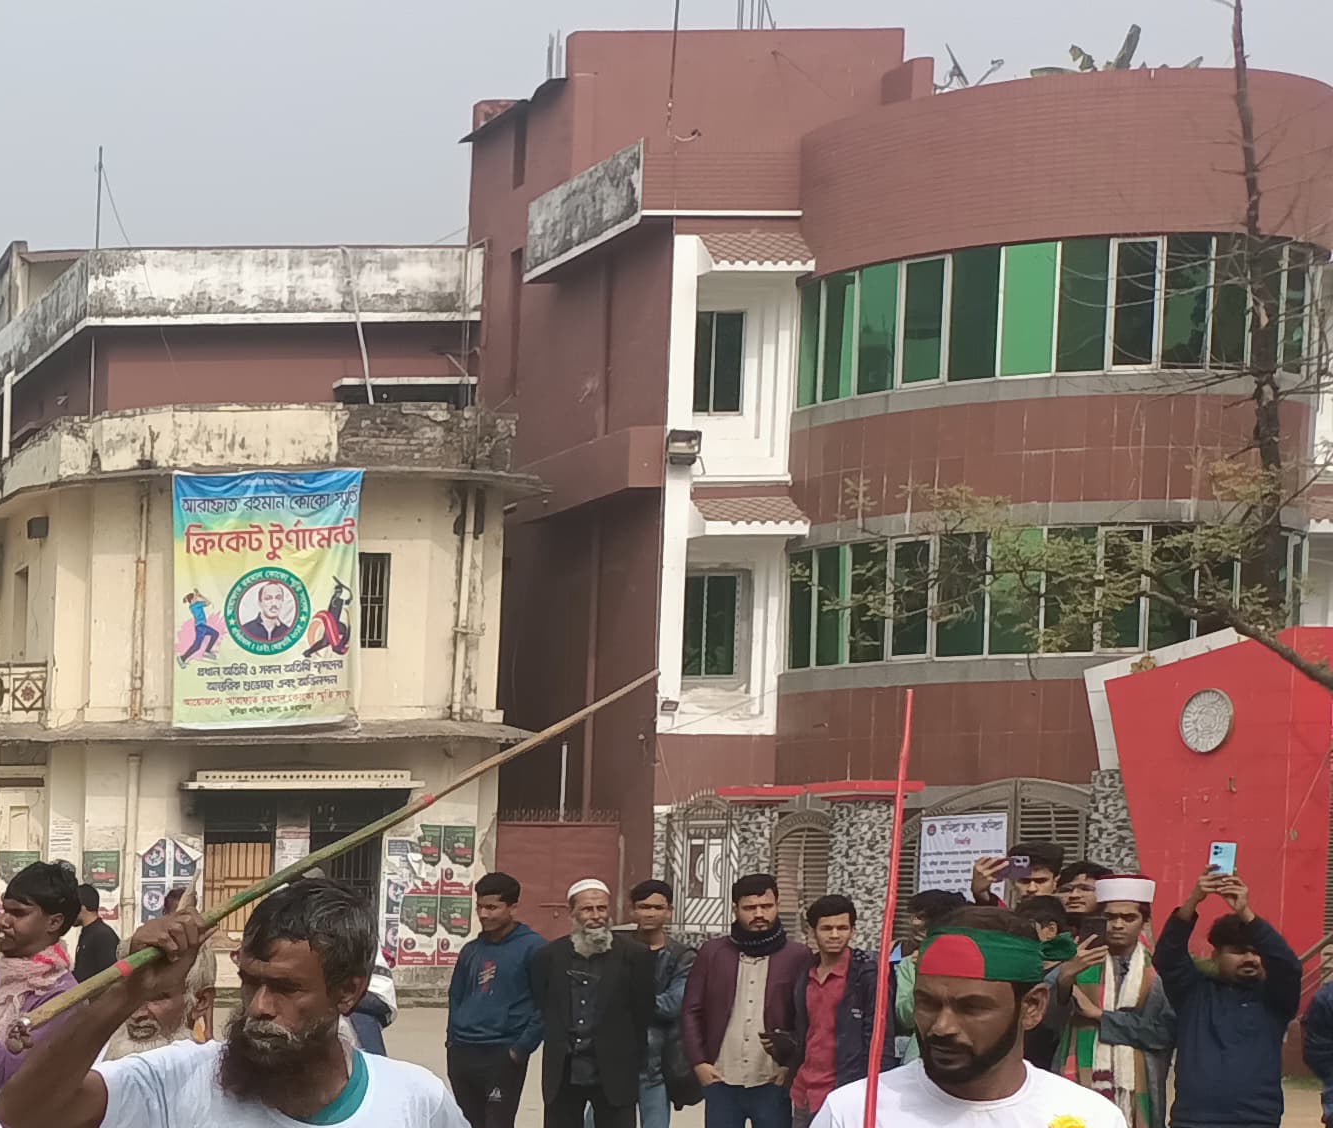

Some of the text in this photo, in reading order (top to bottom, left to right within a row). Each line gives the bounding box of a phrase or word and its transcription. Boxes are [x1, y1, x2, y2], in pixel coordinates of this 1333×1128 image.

[181, 498, 238, 514] আরাফাত
[244, 495, 286, 512] রহমান
[289, 494, 331, 511] কোকো
[185, 524, 264, 556] ক্রিকেট
